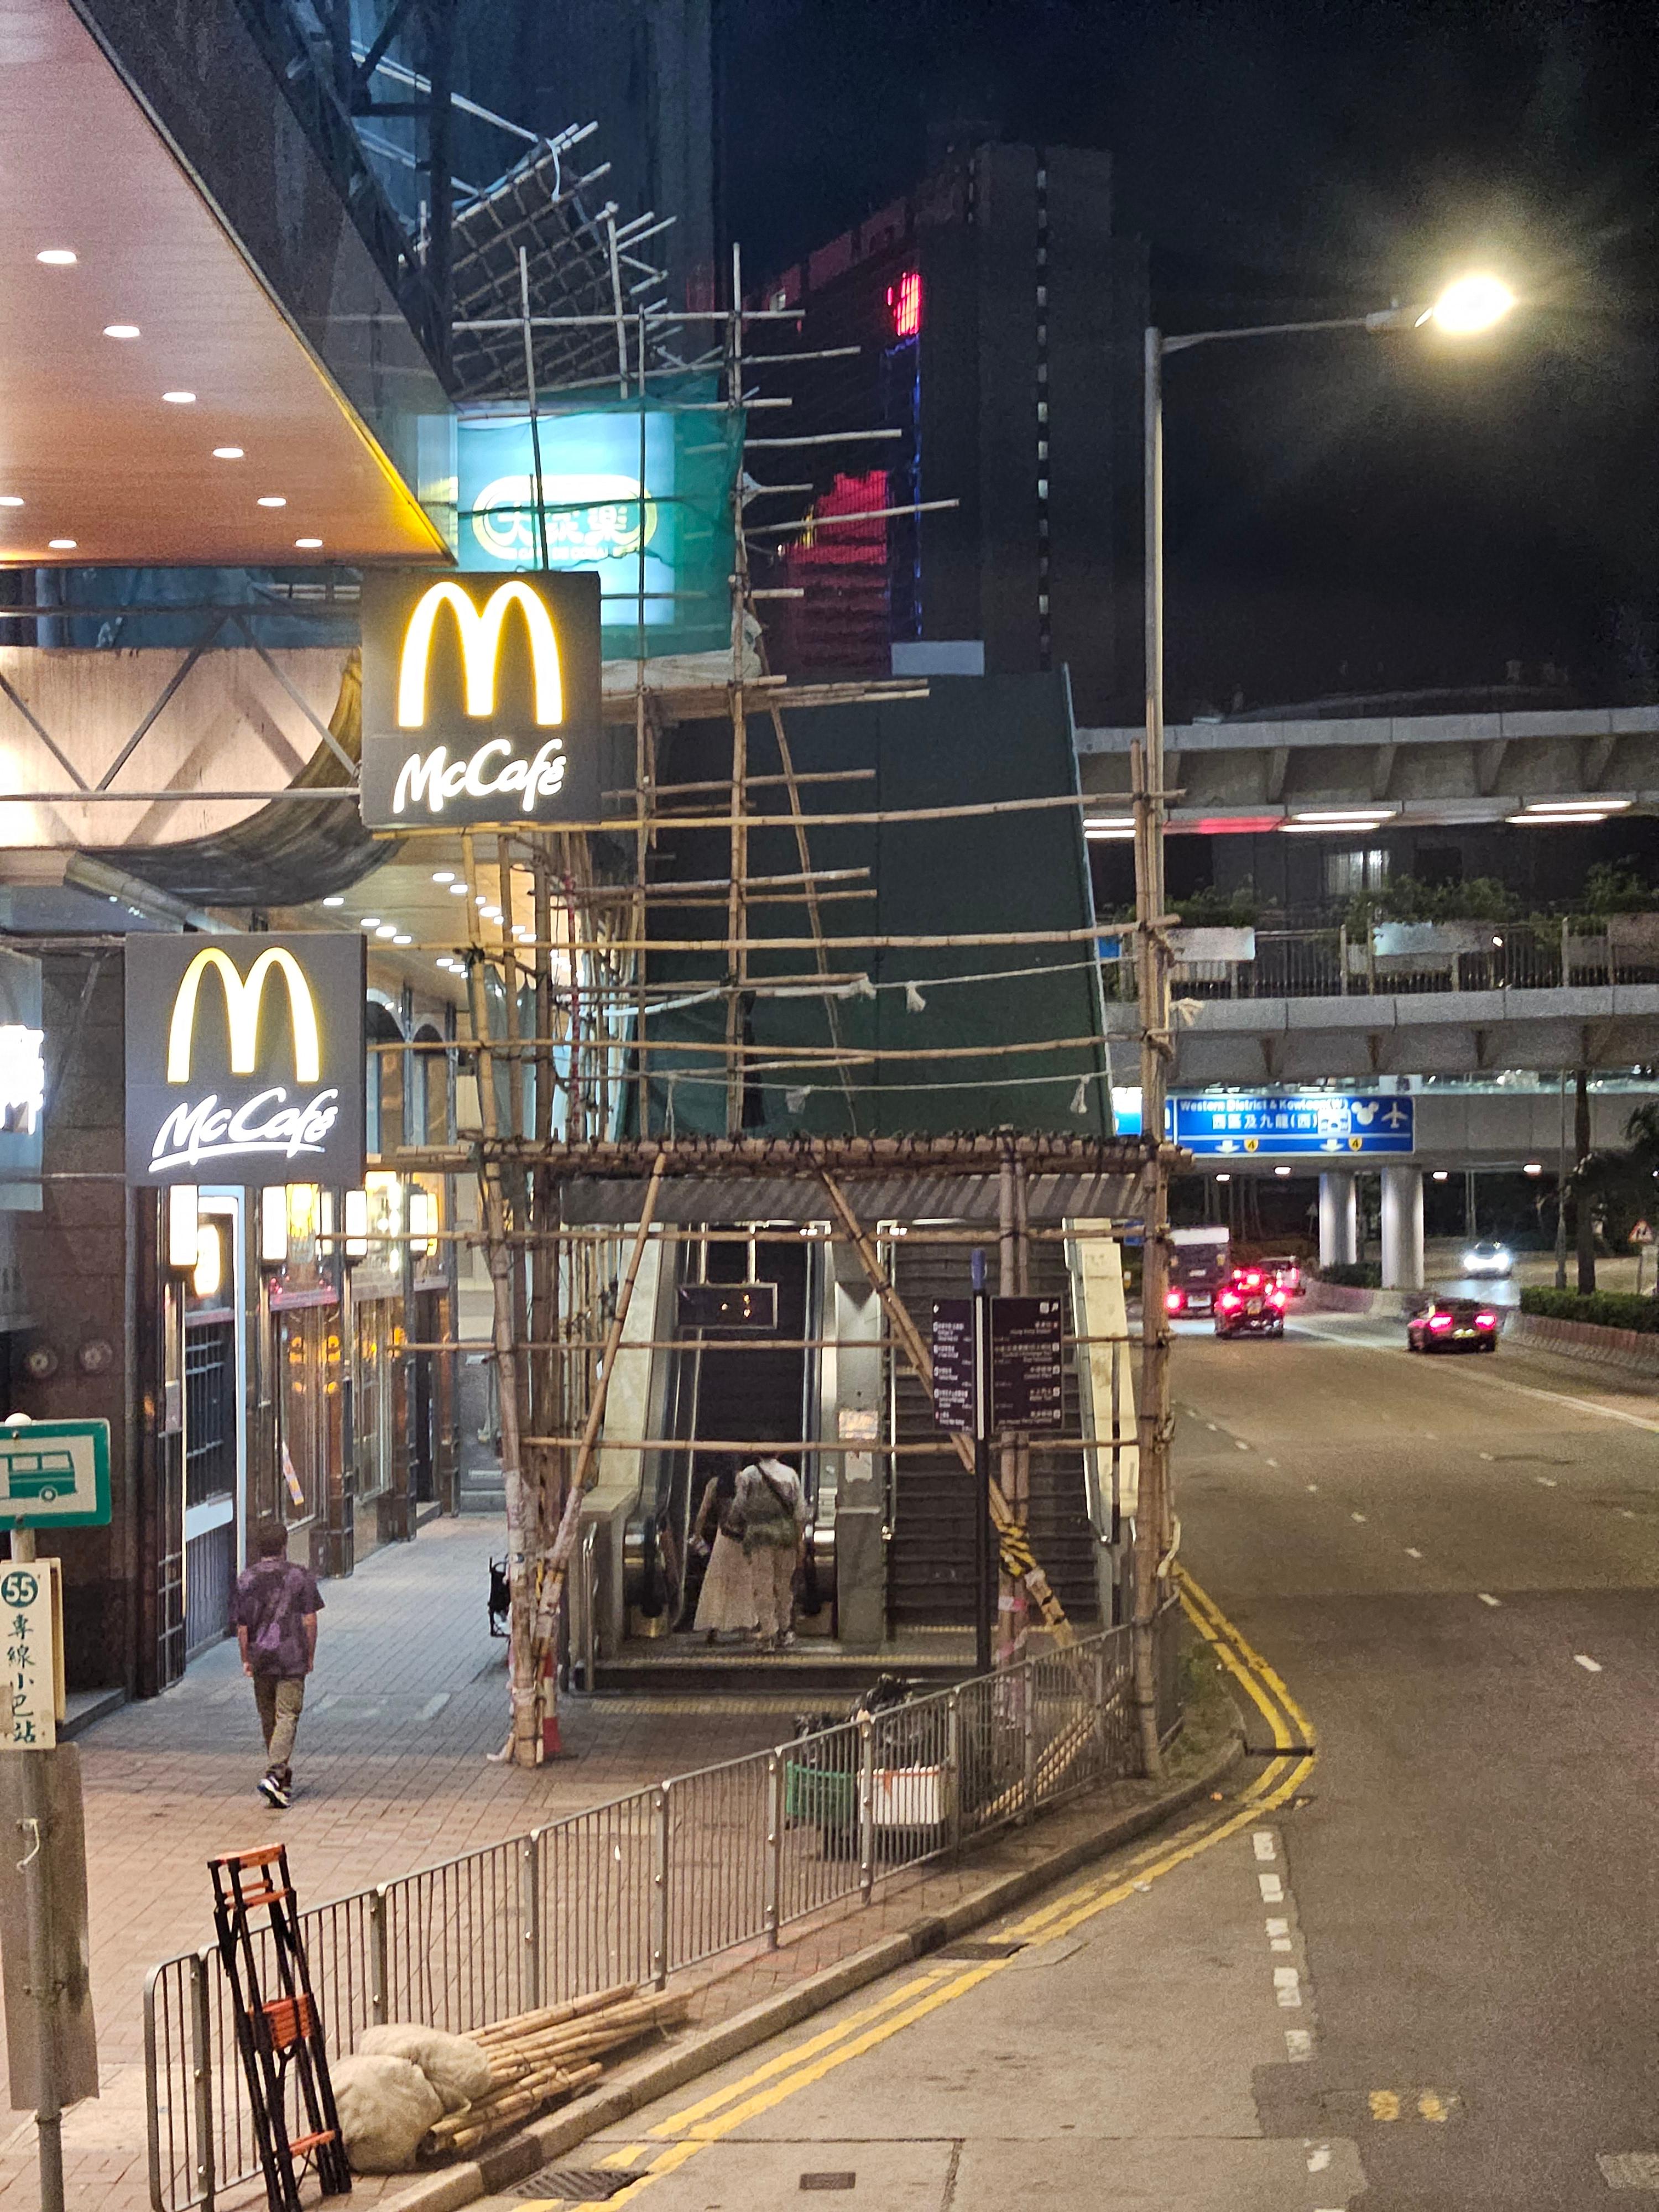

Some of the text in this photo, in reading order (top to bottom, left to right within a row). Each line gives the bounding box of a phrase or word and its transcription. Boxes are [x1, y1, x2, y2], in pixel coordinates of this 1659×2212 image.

[393, 738, 567, 815] McCafé
[149, 1086, 338, 1165] McCafé
[1180, 1099, 1225, 1112] Western
[1226, 1098, 1267, 1112] District
[6, 1575, 34, 1603] 55
[8, 1613, 35, 1743] 專線小巴站
